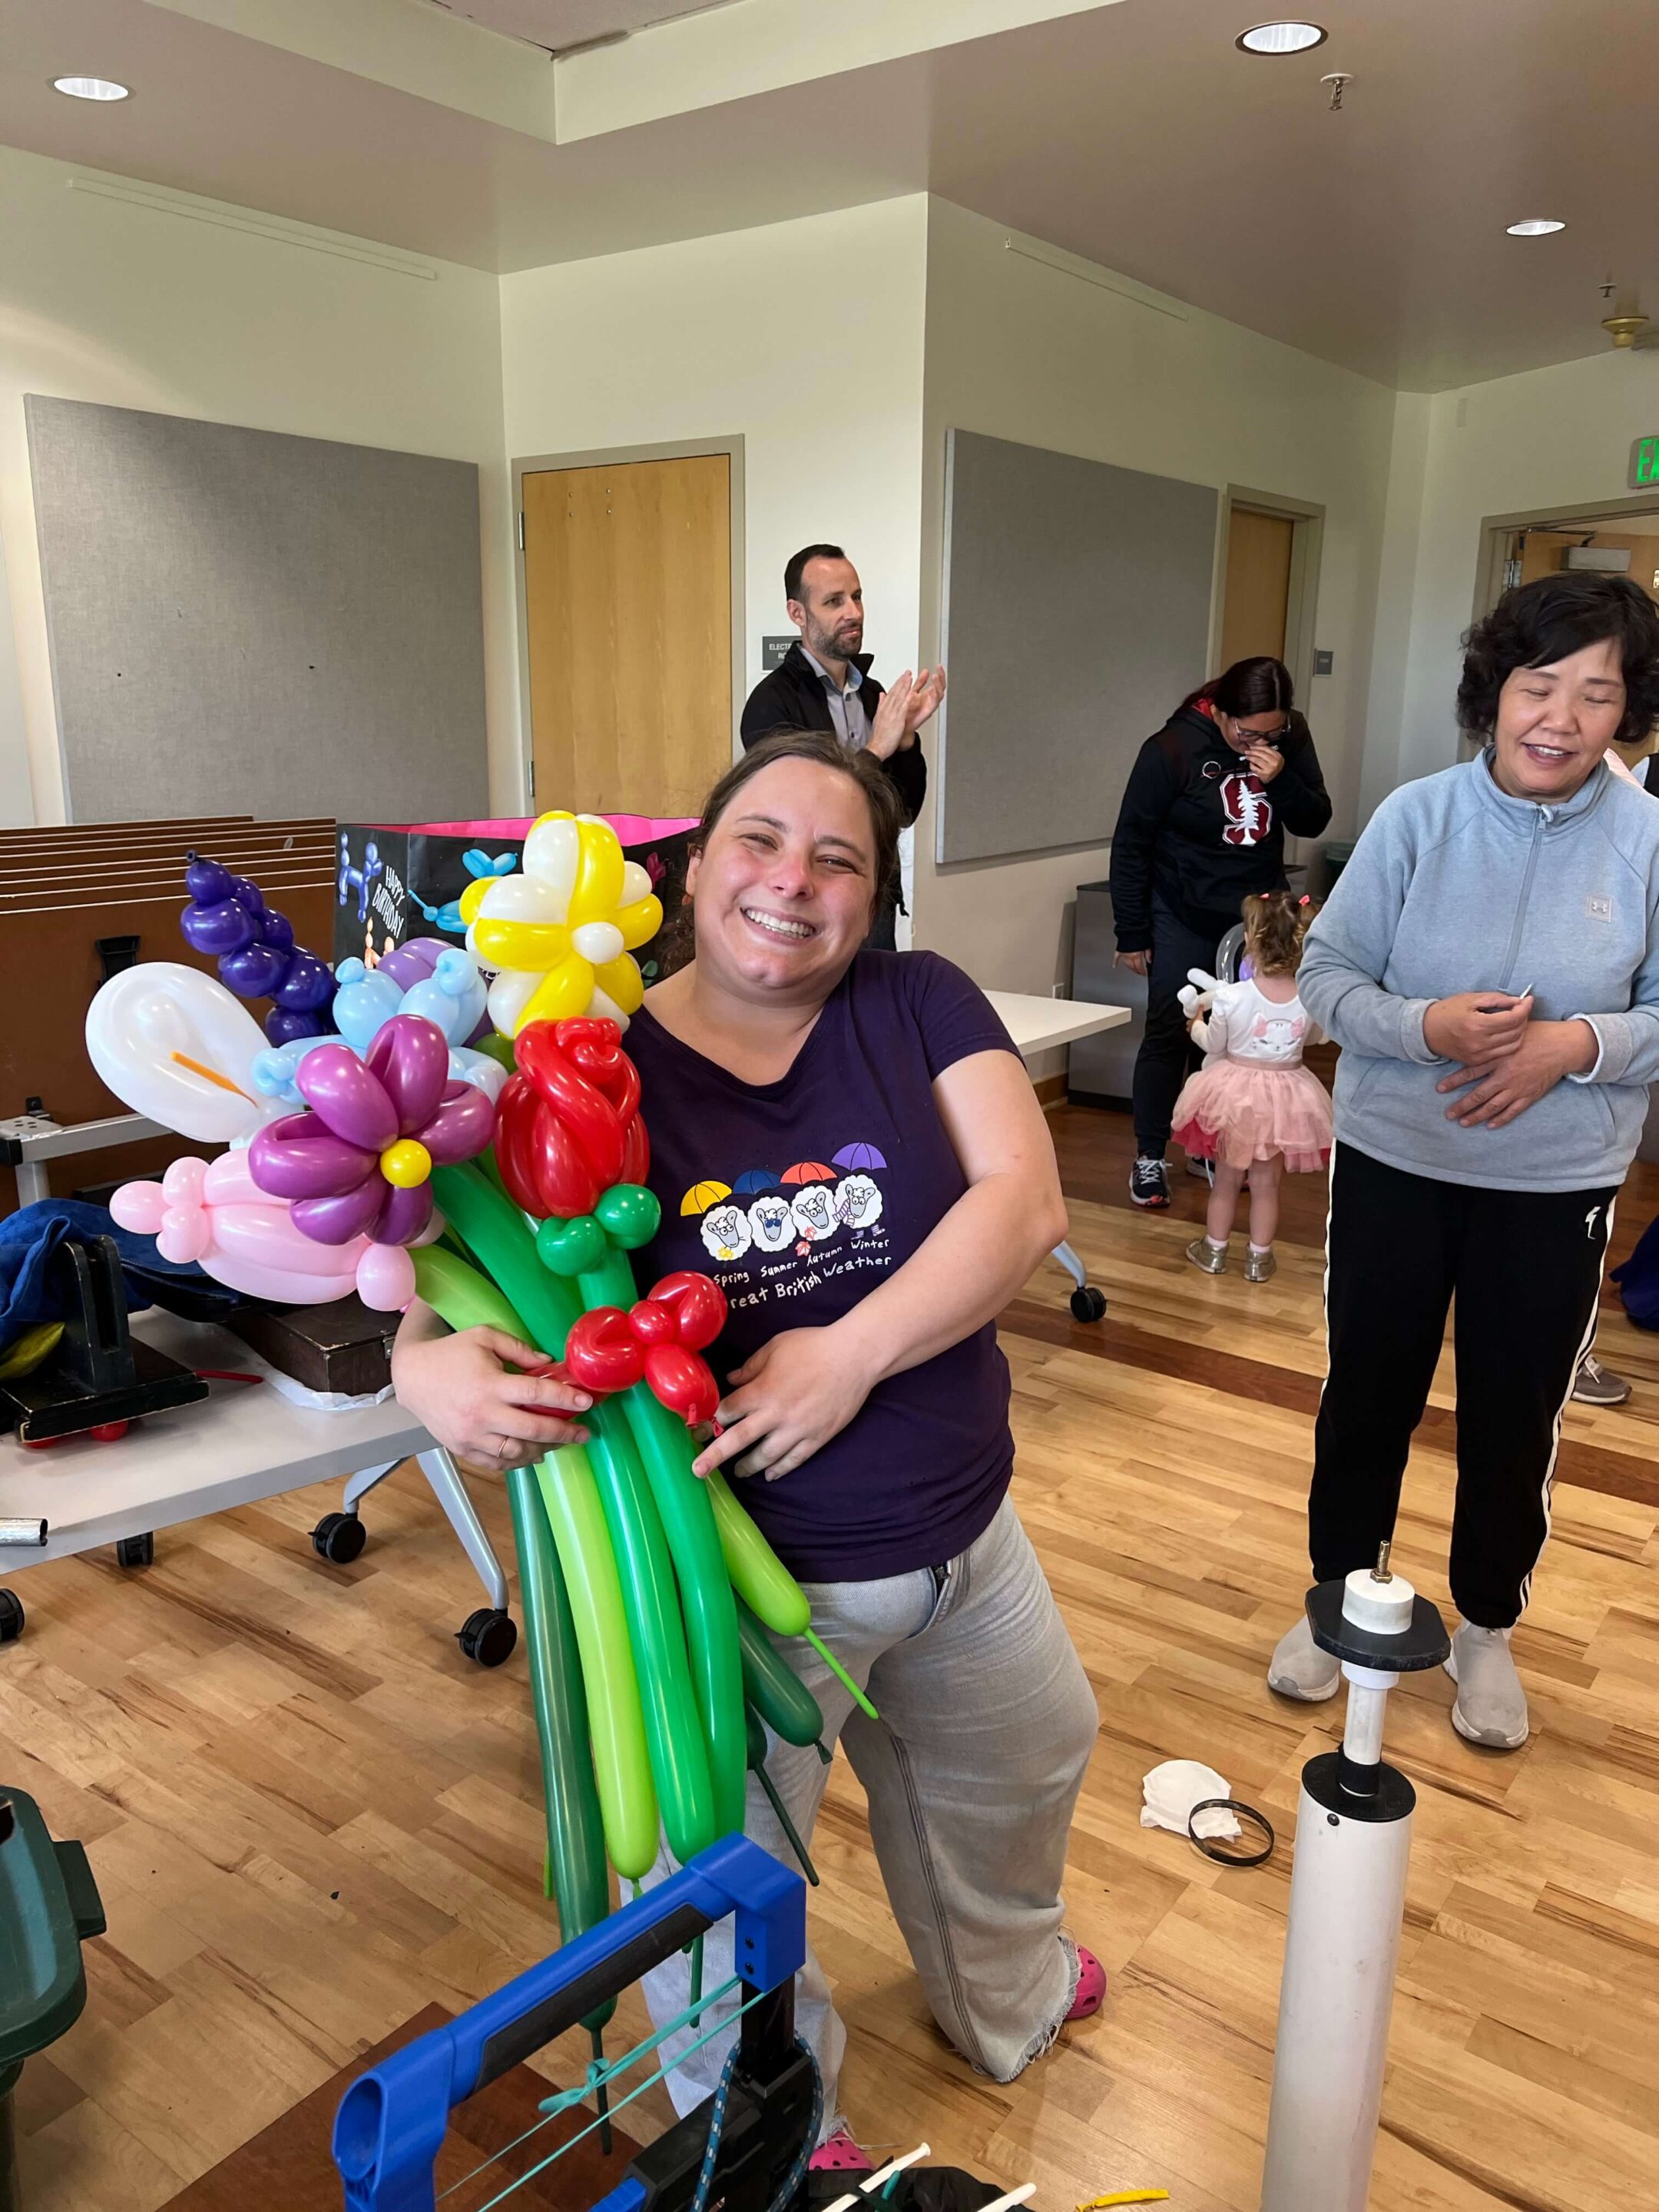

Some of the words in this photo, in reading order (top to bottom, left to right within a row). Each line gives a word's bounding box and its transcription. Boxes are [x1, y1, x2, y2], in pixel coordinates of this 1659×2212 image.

[372, 882, 404, 939] BIRTHDAY
[386, 865, 406, 906] HAPPY
[714, 1272, 750, 1287] Spring
[760, 1261, 798, 1277] Summer
[806, 1246, 843, 1267] Autumn
[850, 1239, 889, 1250] Winter
[730, 1286, 768, 1309] reat
[774, 1270, 822, 1298] British
[823, 1257, 892, 1277] Weather
